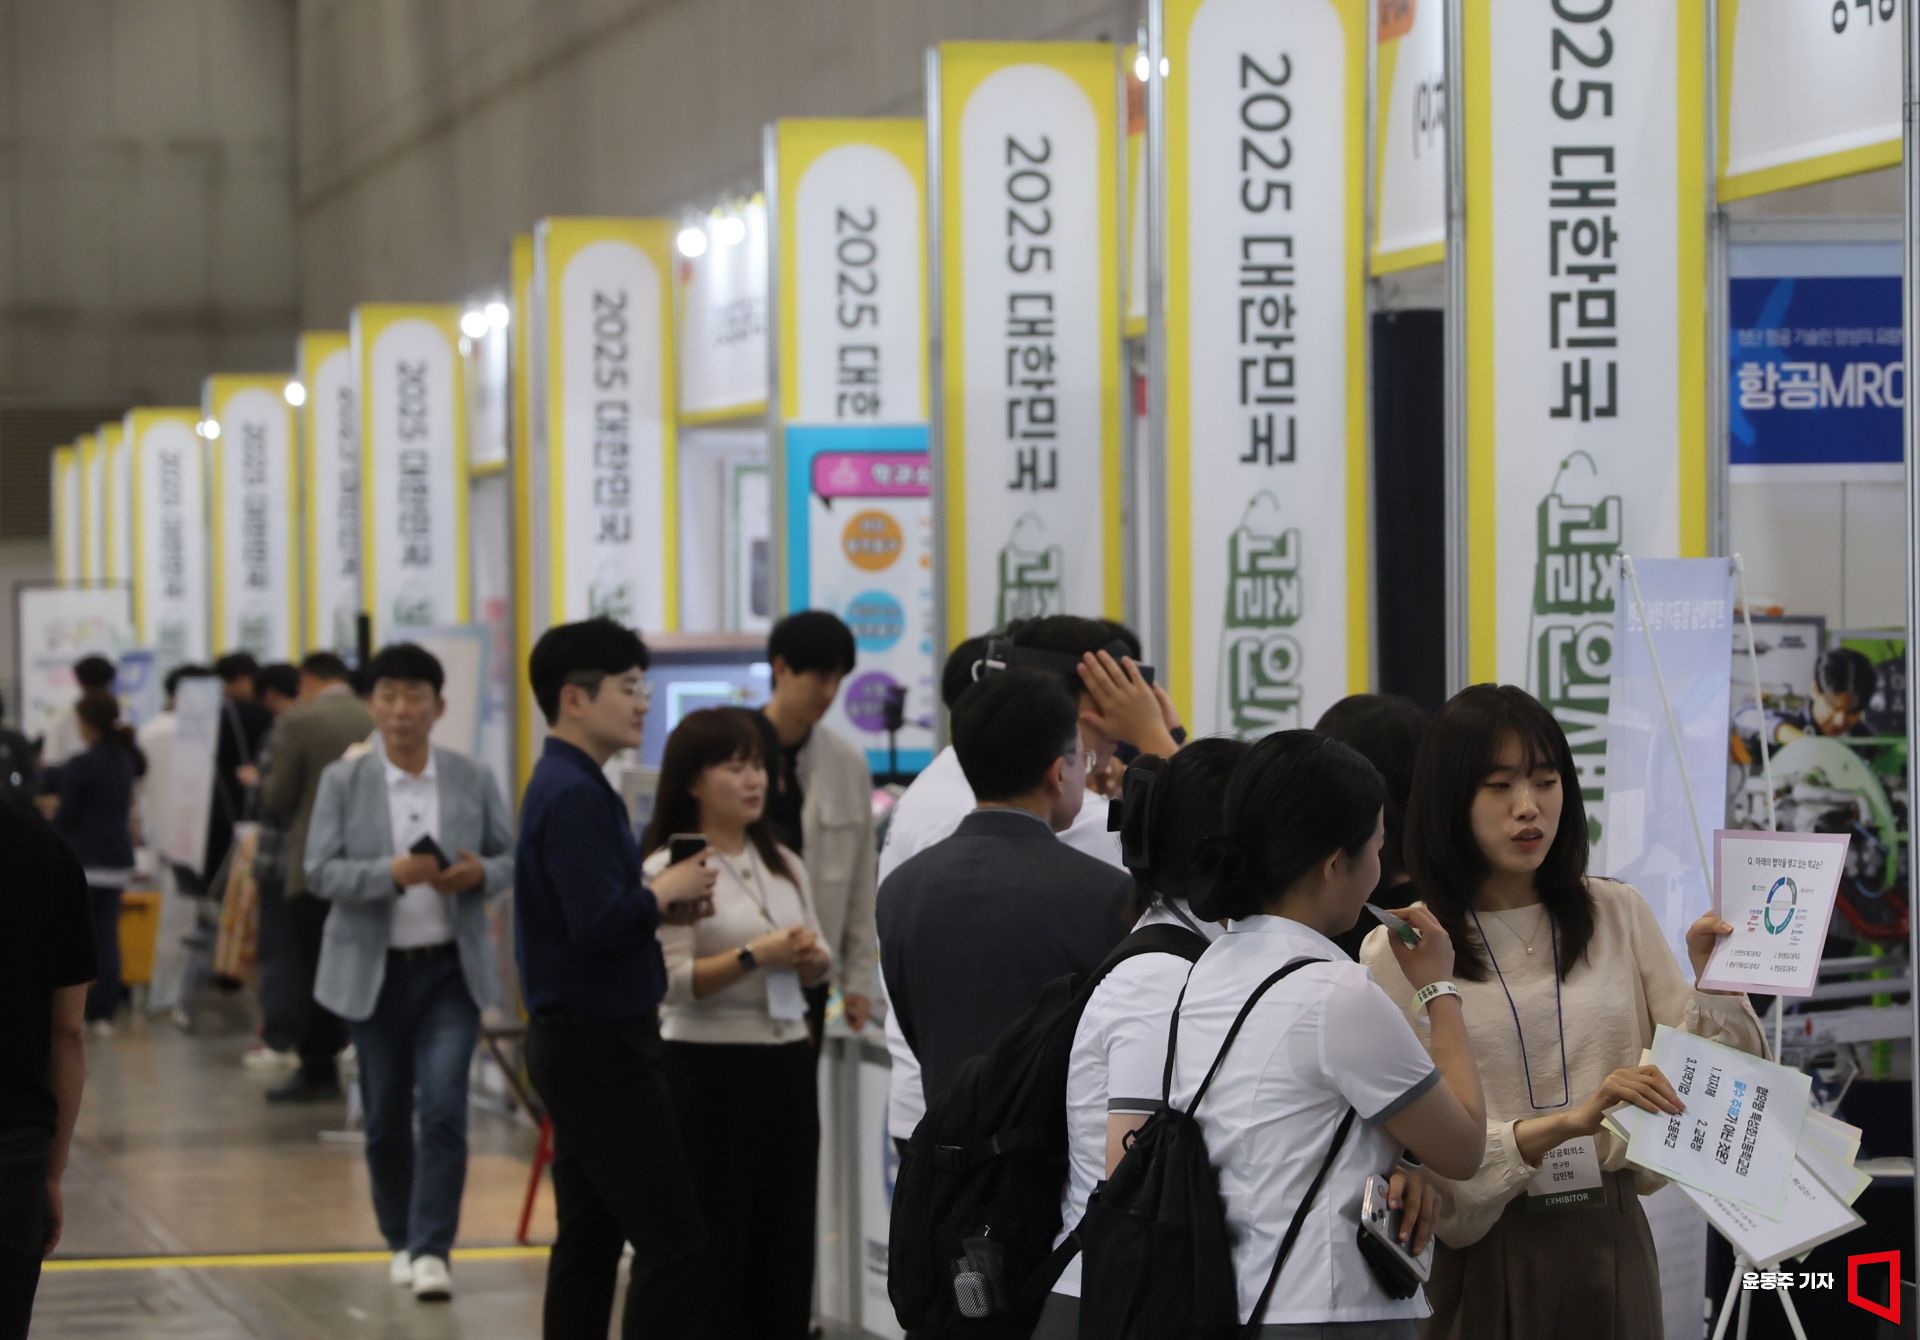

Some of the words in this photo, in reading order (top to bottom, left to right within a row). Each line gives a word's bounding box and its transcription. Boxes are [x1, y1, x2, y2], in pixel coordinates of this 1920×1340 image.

[1240, 53, 1292, 213] 2025
[1006, 135, 1053, 274] 2025
[836, 206, 880, 330] 2025
[1549, 147, 1617, 421] 대한민국
[592, 289, 629, 391] 2025
[1239, 235, 1296, 466] 대한민국
[397, 358, 428, 442] 2025
[1006, 292, 1057, 492] 대한민국
[594, 400, 632, 545] 대한민국
[1678, 1064, 1696, 1096] 지역기업
[1704, 1073, 1720, 1098] 지자체
[1752, 1086, 1769, 1112] 협약형
[1664, 1117, 1681, 1149] 초등학교
[1690, 1128, 1706, 1152] 교육청
[1714, 1142, 1731, 1165] 것은?
[1720, 1124, 1736, 1143] 아닌
[1735, 1111, 1762, 1177] 특성화고등학교의
[1545, 1192, 1589, 1206] EXHIBITOR
